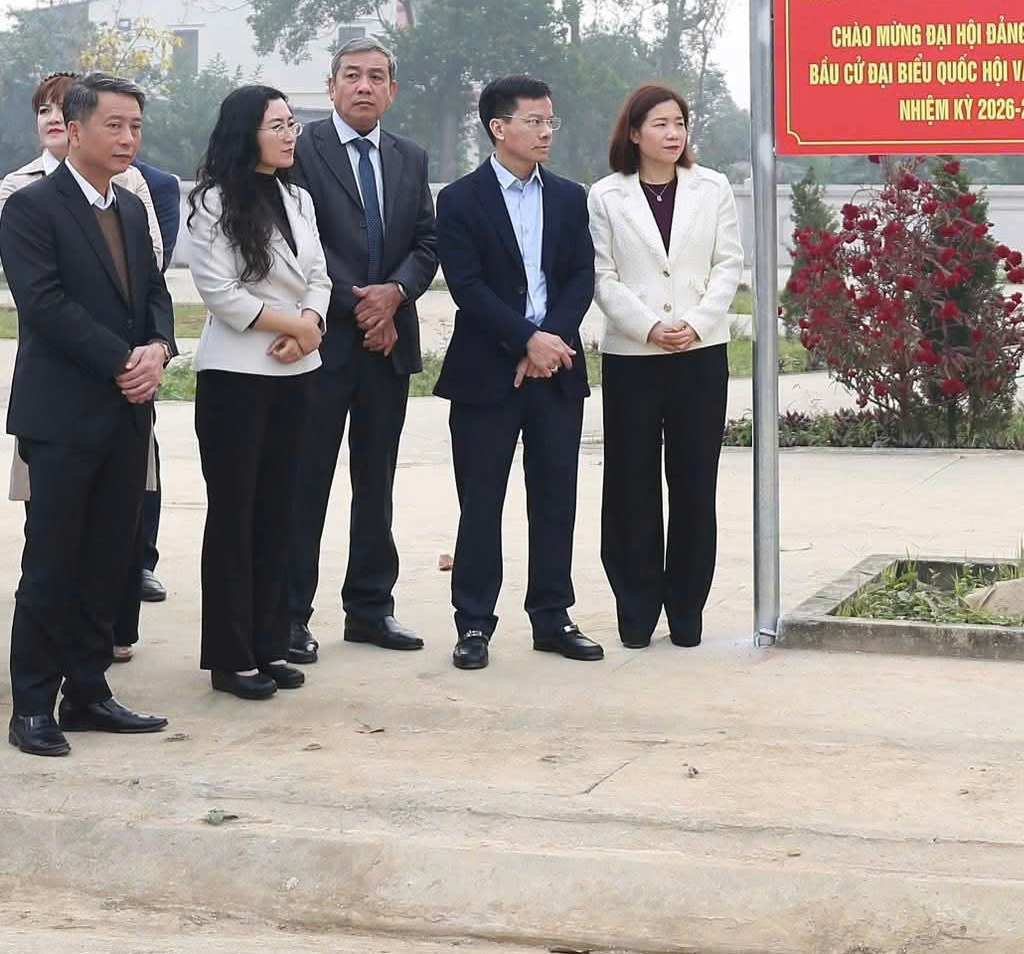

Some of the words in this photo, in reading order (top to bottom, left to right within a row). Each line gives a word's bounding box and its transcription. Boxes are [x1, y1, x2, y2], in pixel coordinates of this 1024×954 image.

[831, 21, 872, 48] CHÀO
[875, 20, 922, 47] MỪNG
[925, 23, 952, 51] ĐẠI
[956, 18, 982, 50] HỘI
[809, 55, 840, 86] BẦU
[843, 55, 866, 85] CỬ
[867, 61, 894, 89] ĐẠI
[897, 52, 933, 84] BIỂU
[936, 53, 978, 86] QUỐC
[981, 55, 1009, 87] HỘI
[899, 94, 950, 126] NHIỆM
[953, 93, 974, 121] KỲ
